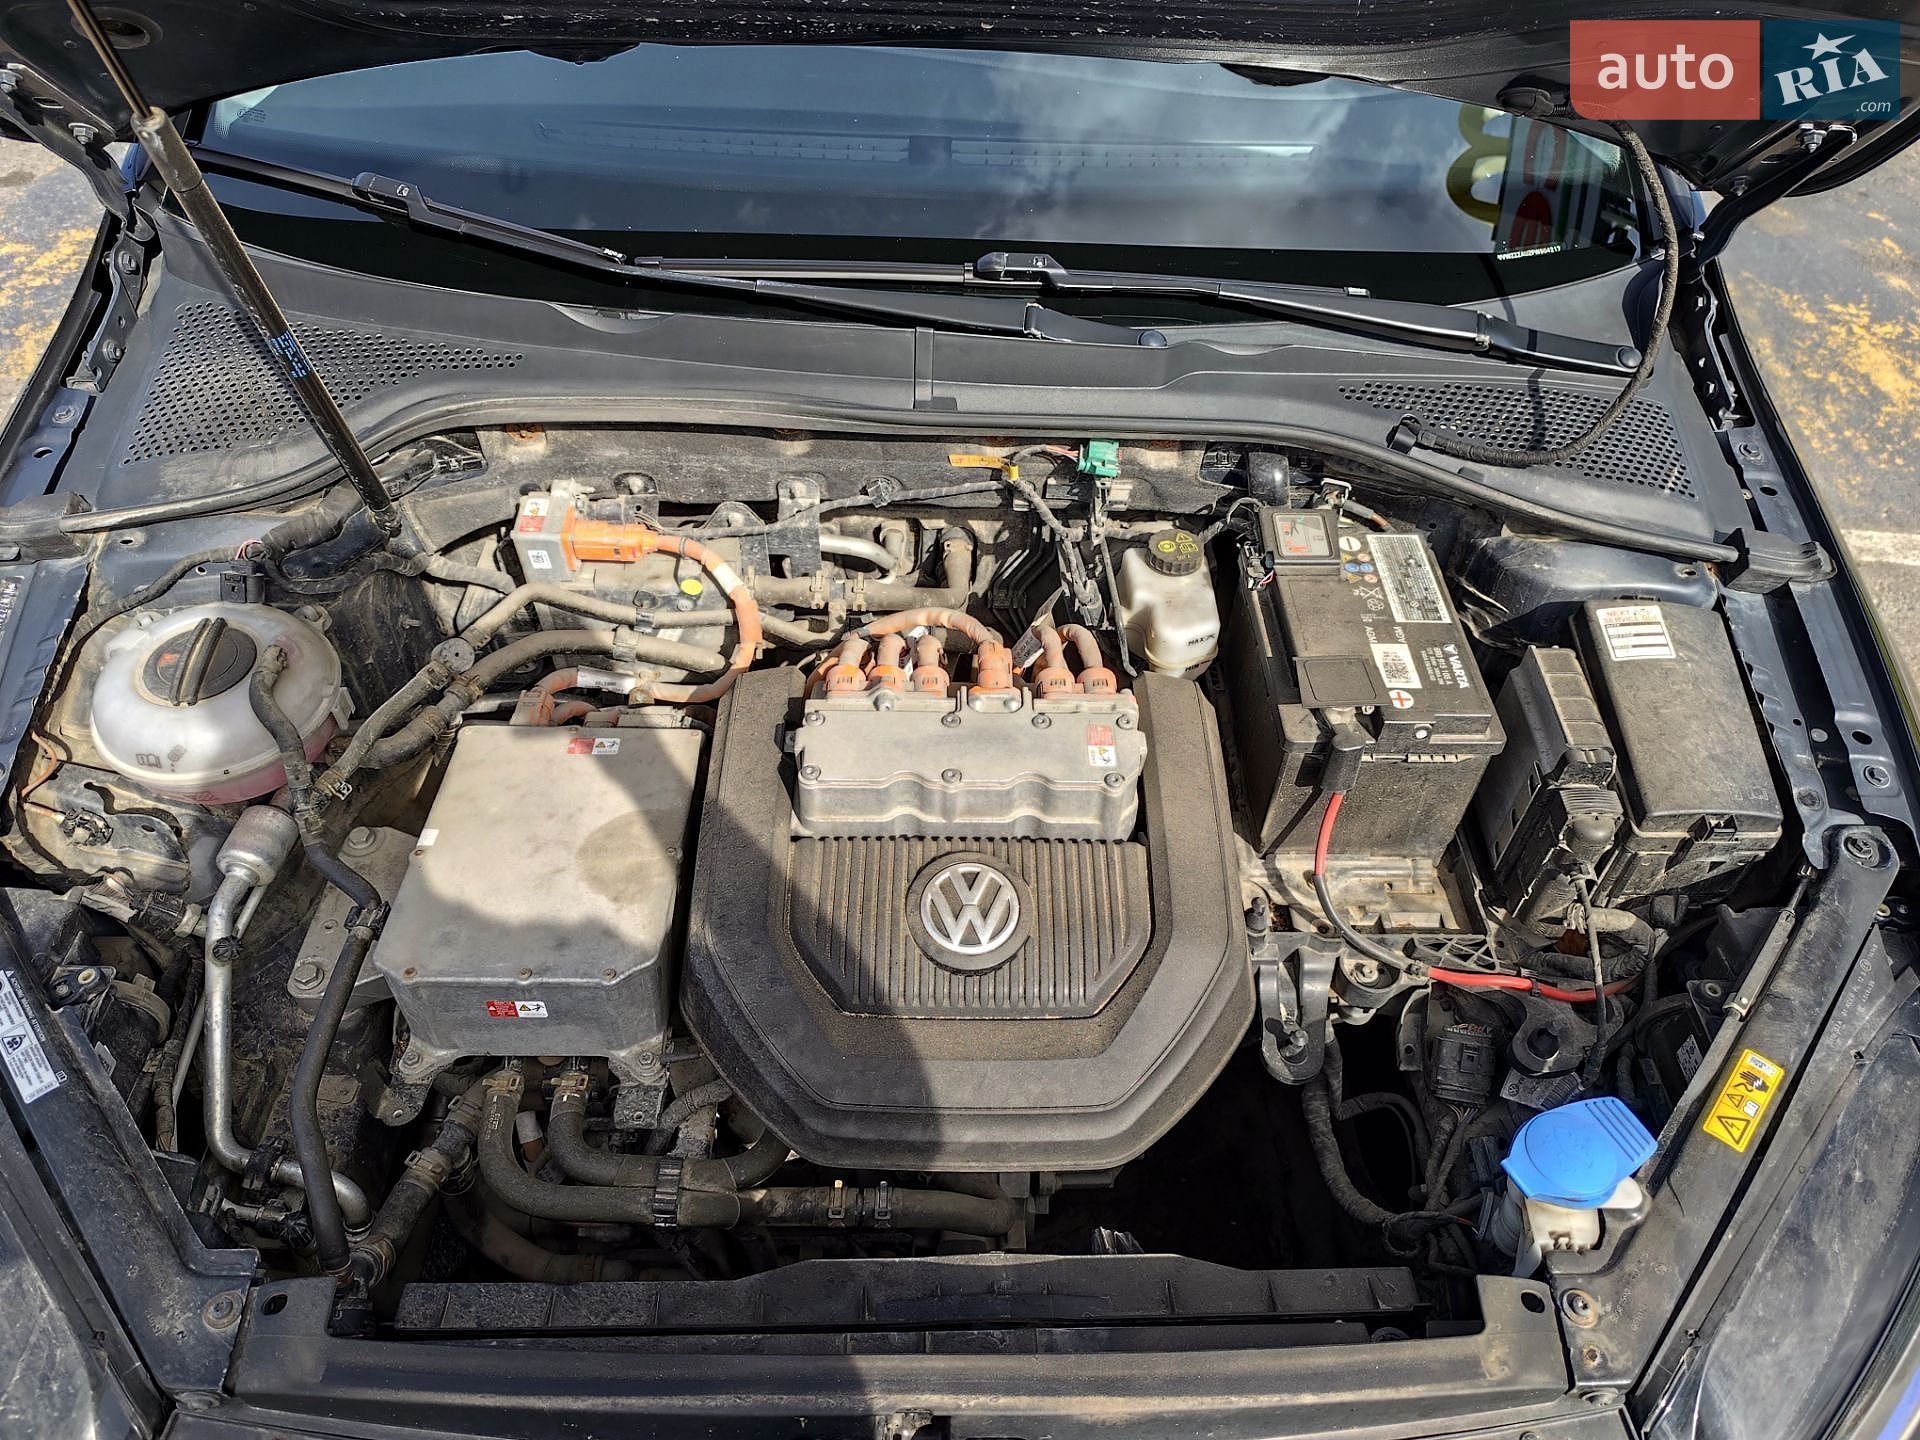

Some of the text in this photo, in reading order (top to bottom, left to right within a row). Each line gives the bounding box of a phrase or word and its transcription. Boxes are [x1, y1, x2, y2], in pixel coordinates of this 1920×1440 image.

[1187, 636, 1204, 647] MAX
[1364, 626, 1378, 643] AGM
[1184, 663, 1200, 672] MIN
[1449, 655, 1470, 689] VARTA
